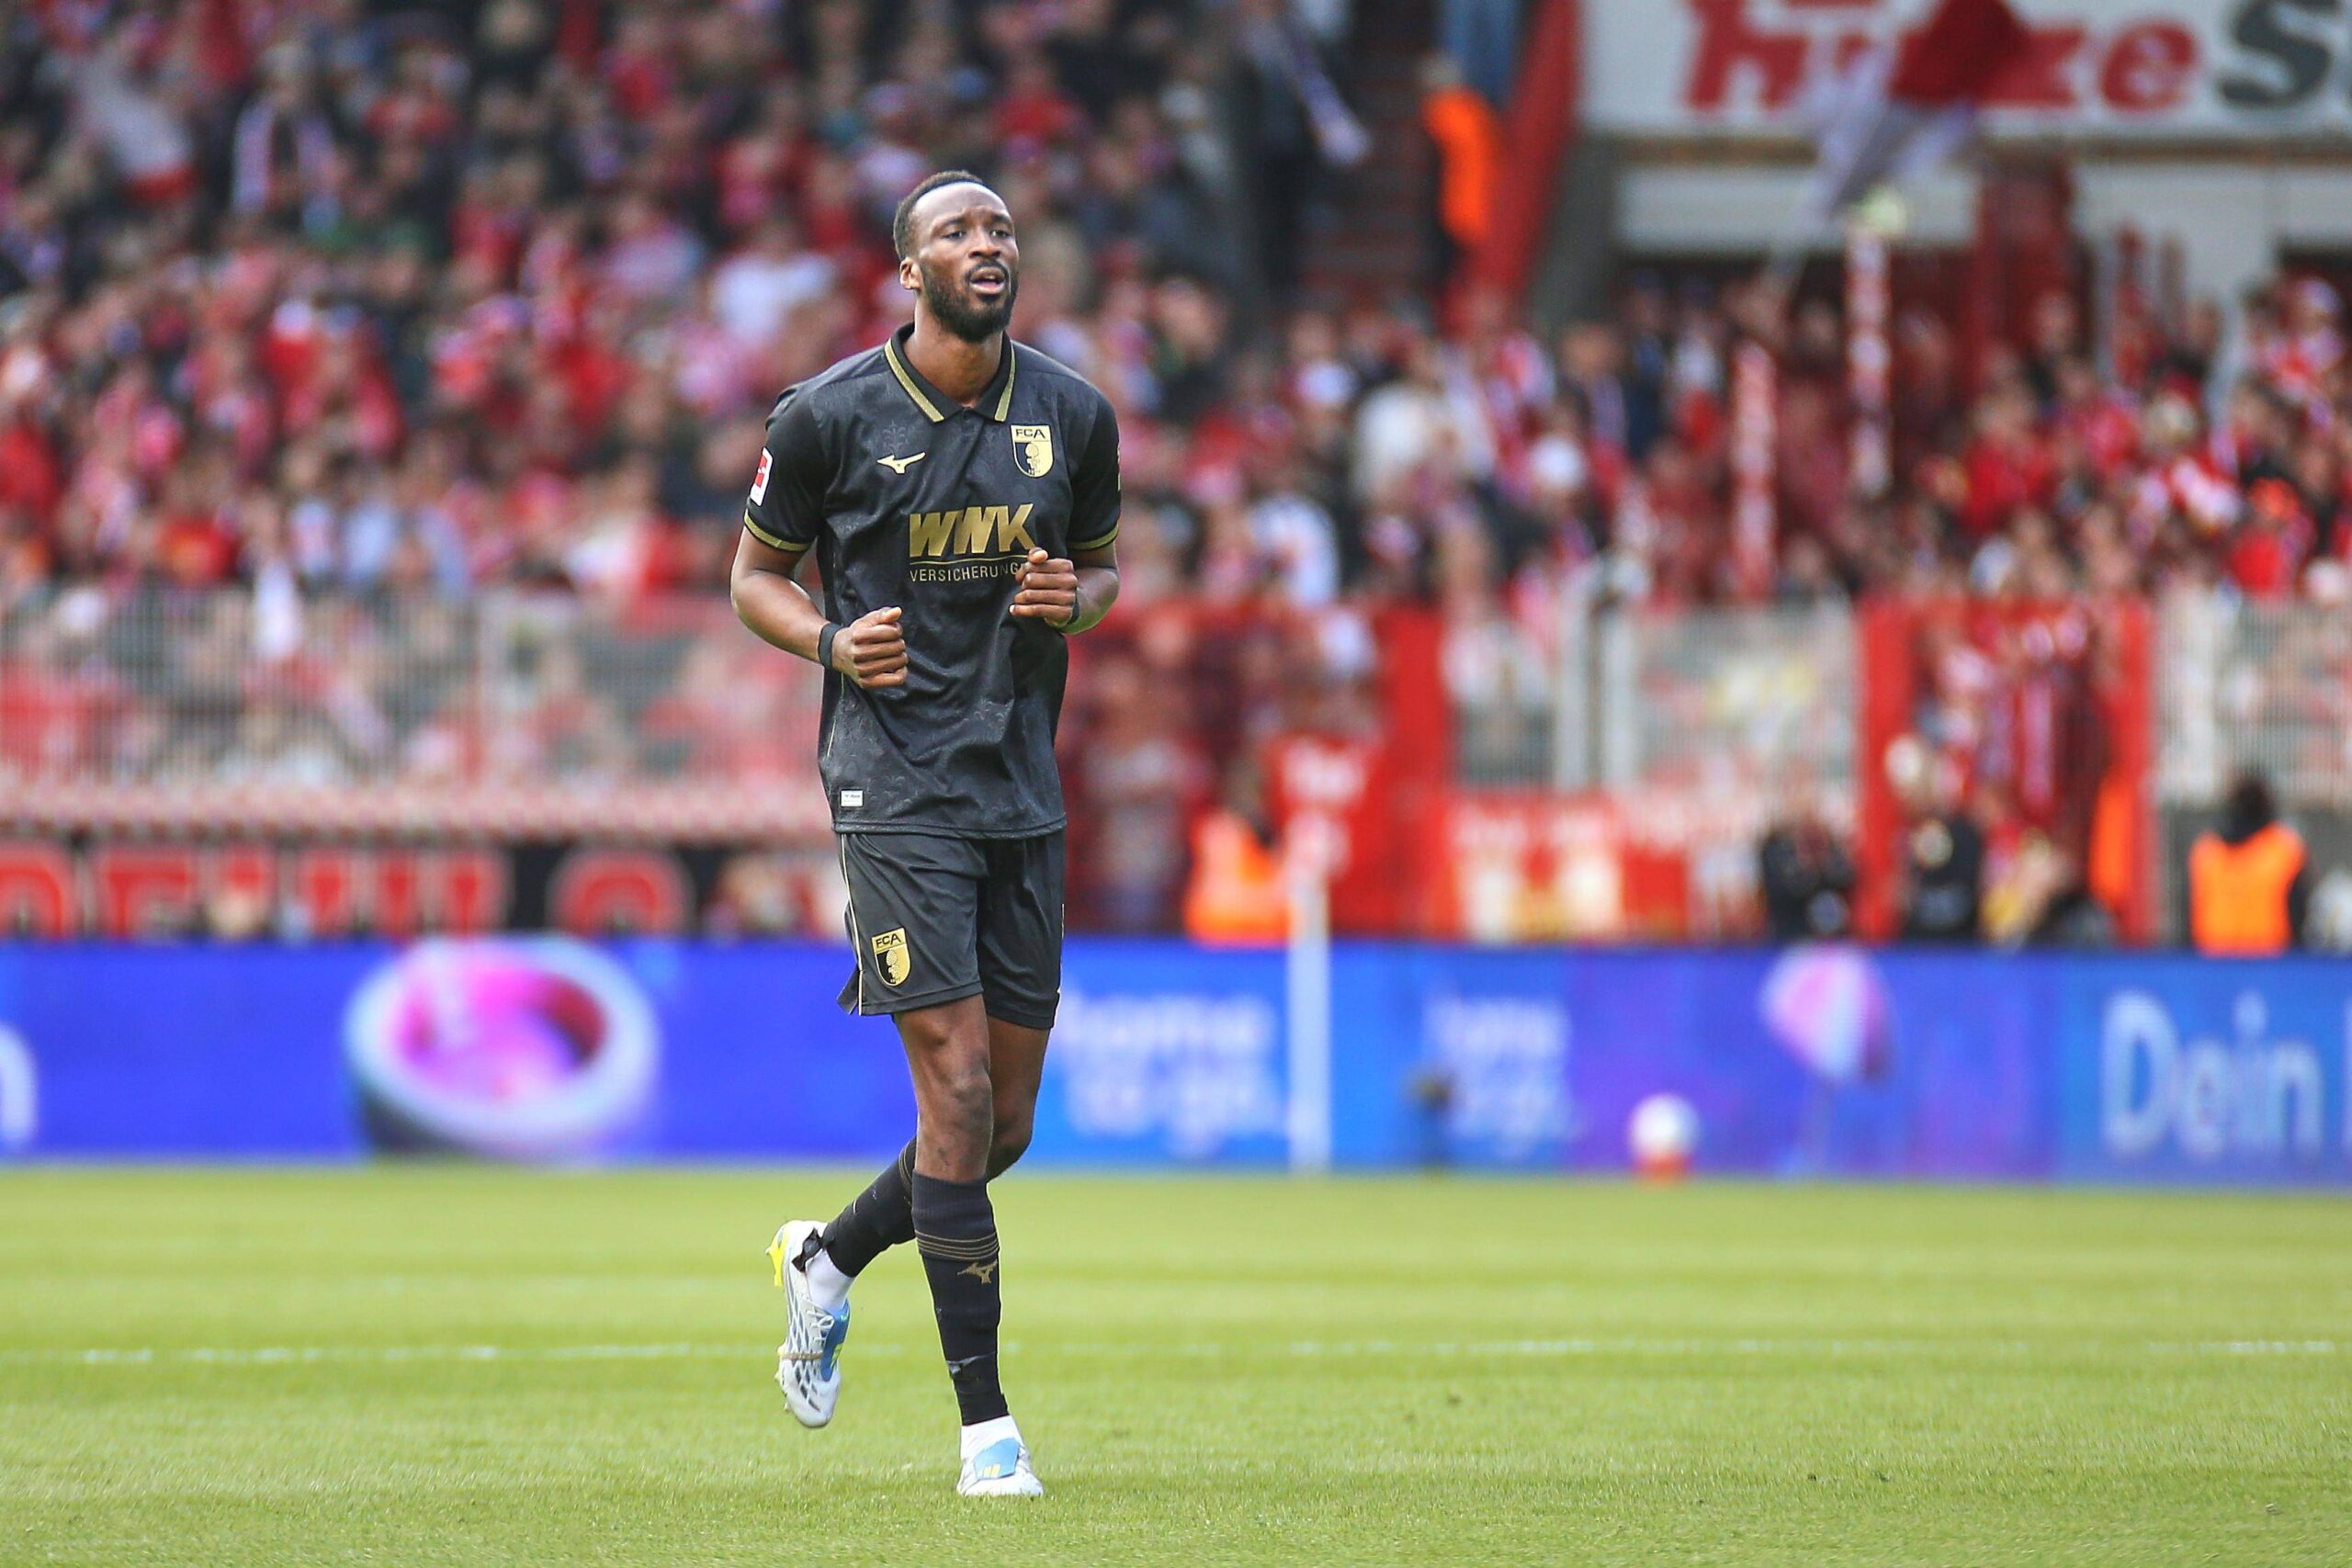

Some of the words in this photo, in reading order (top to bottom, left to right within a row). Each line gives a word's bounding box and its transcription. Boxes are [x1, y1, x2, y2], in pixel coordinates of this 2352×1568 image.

[1015, 428, 1046, 439] FCA
[910, 503, 1035, 558] WWK
[876, 933, 901, 948] FCA
[2101, 990, 2324, 1156] Dein
